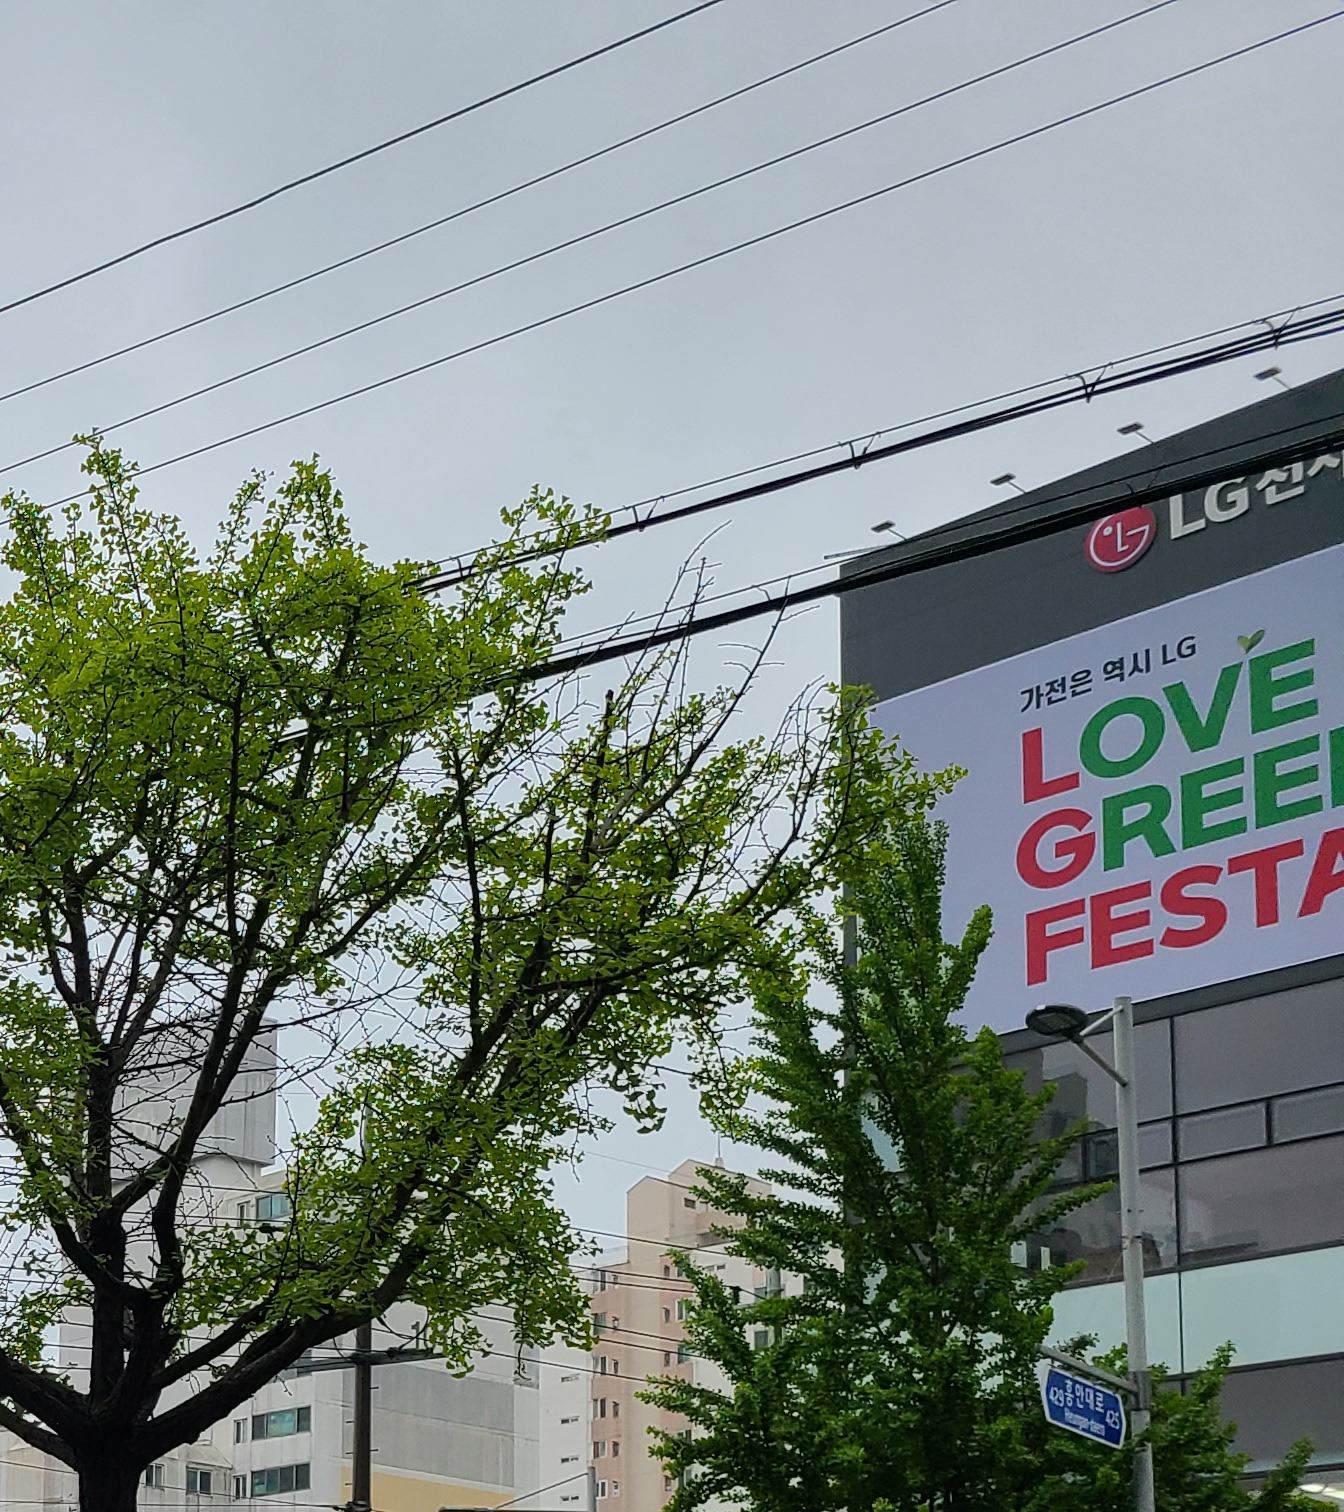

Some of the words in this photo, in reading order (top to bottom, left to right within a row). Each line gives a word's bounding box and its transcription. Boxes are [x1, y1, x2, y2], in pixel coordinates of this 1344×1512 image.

[1020, 668, 1093, 713] 가전은
[1102, 648, 1152, 684] 역시
[1160, 635, 1198, 666] LG
[1021, 638, 1320, 805] LOVE
[1015, 726, 1344, 890] GREE
[1064, 1379, 1105, 1414] 흥안대로
